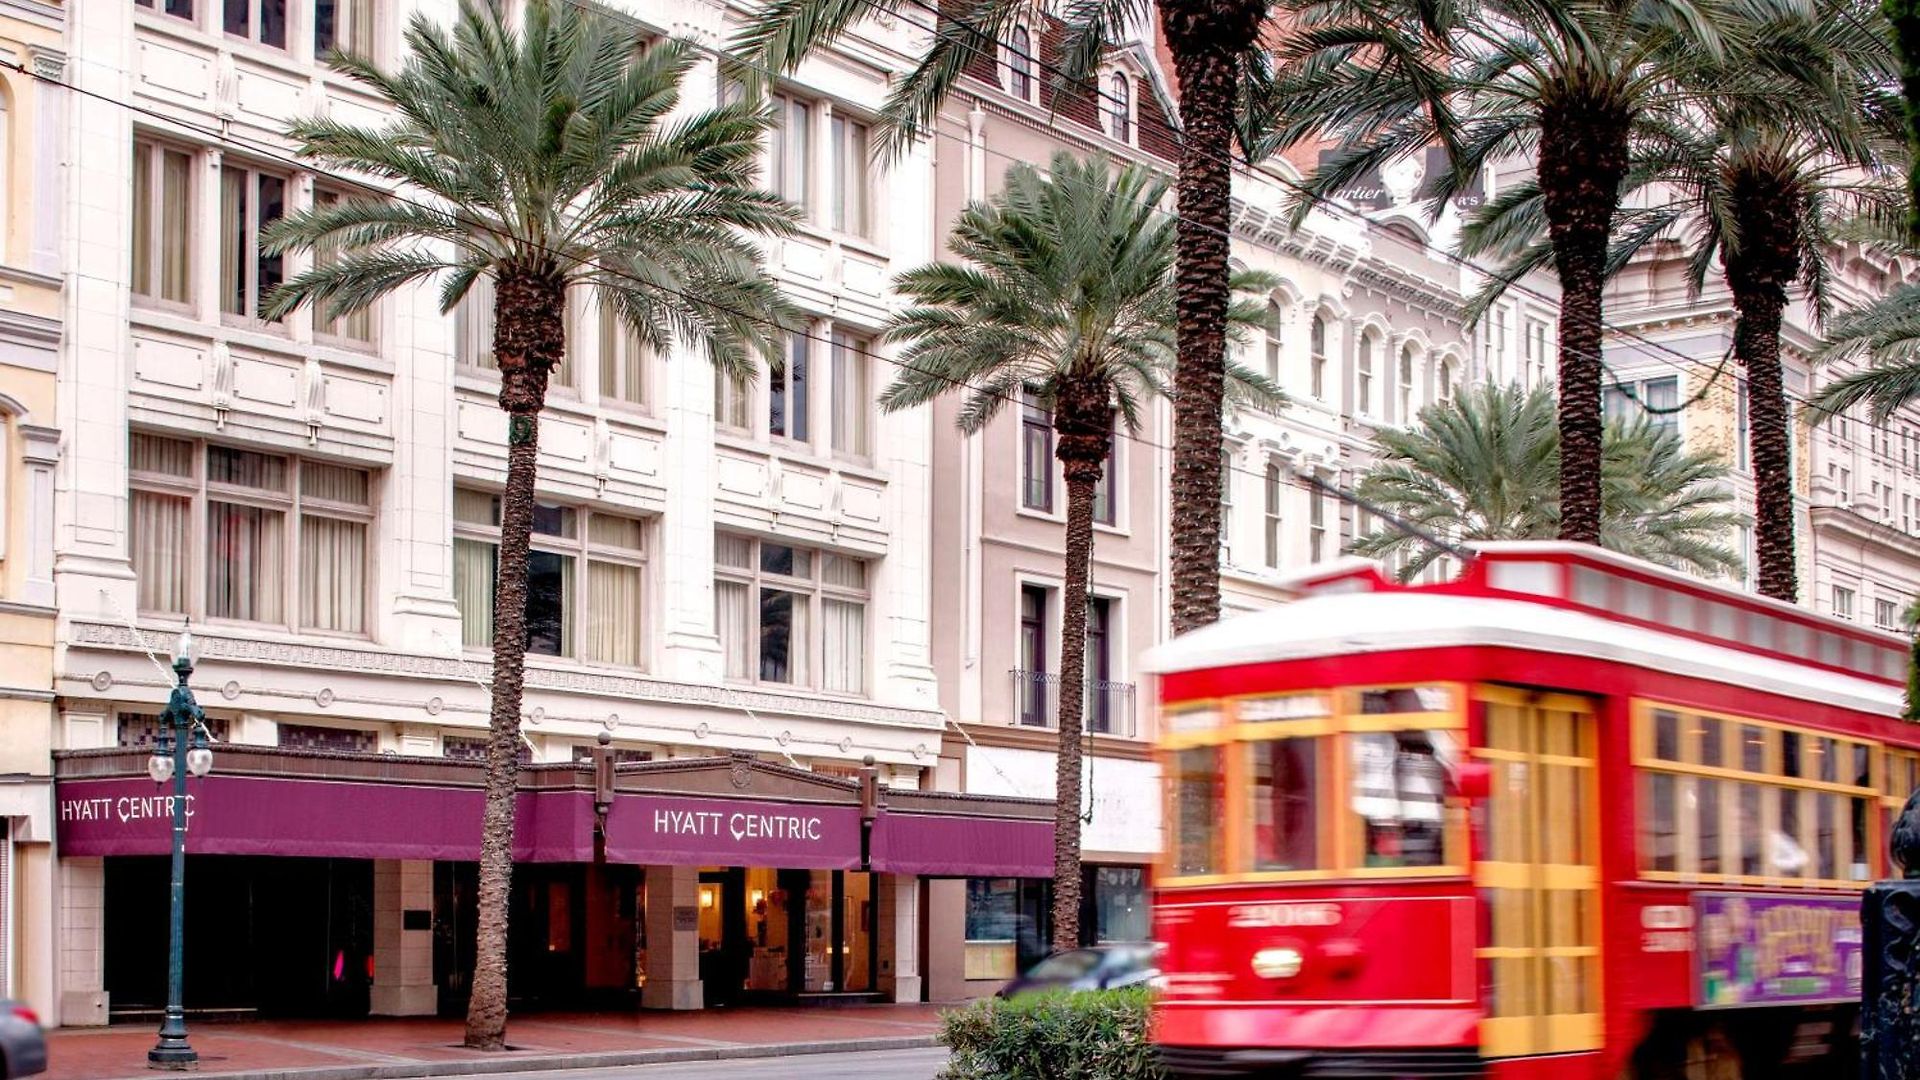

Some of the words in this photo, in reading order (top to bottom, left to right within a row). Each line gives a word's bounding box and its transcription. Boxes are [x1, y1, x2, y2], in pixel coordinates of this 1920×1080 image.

[62, 799, 112, 821] HYATT
[117, 795, 195, 822] CENTRC
[655, 810, 723, 835] HYATT
[730, 812, 821, 840] CENTRIC
